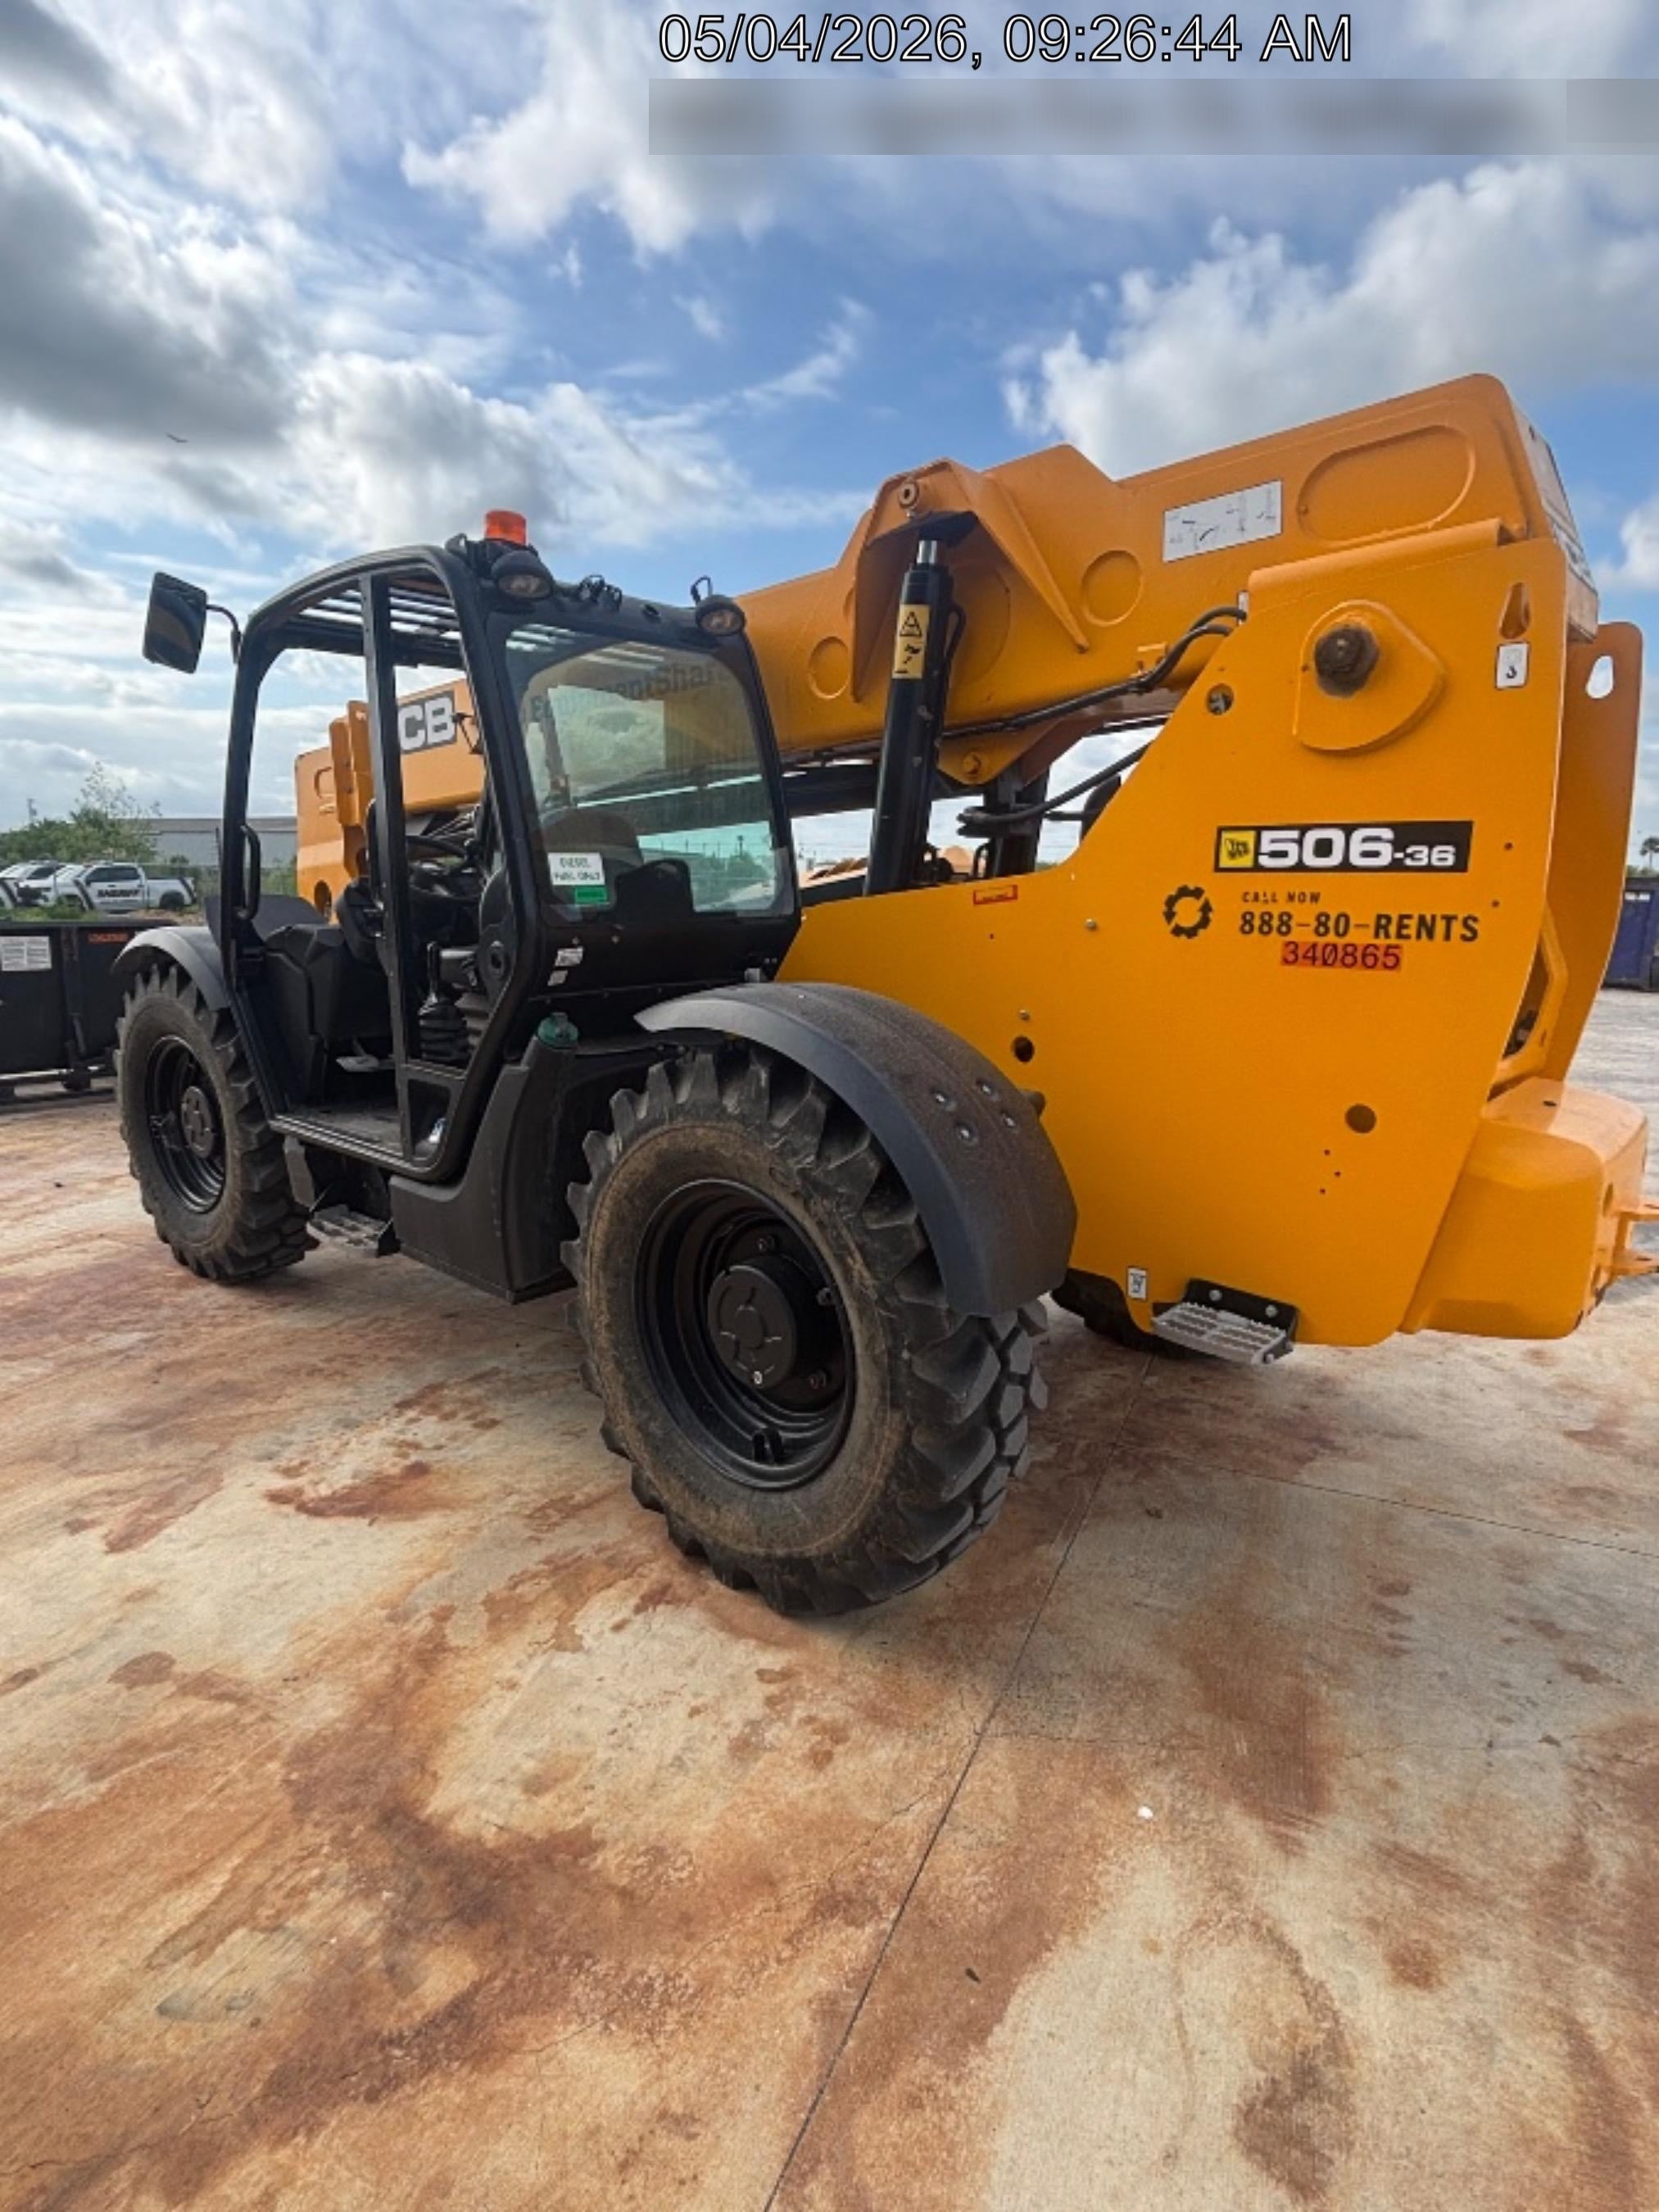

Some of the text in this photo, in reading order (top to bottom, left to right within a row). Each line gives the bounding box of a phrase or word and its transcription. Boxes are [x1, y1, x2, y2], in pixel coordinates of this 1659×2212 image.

[397, 696, 456, 751] CB
[1258, 827, 1456, 868] 506-36
[1242, 891, 1321, 904] CALL NOW
[1240, 911, 1480, 942] 888-80-RENTS
[1283, 941, 1401, 970] 340865
